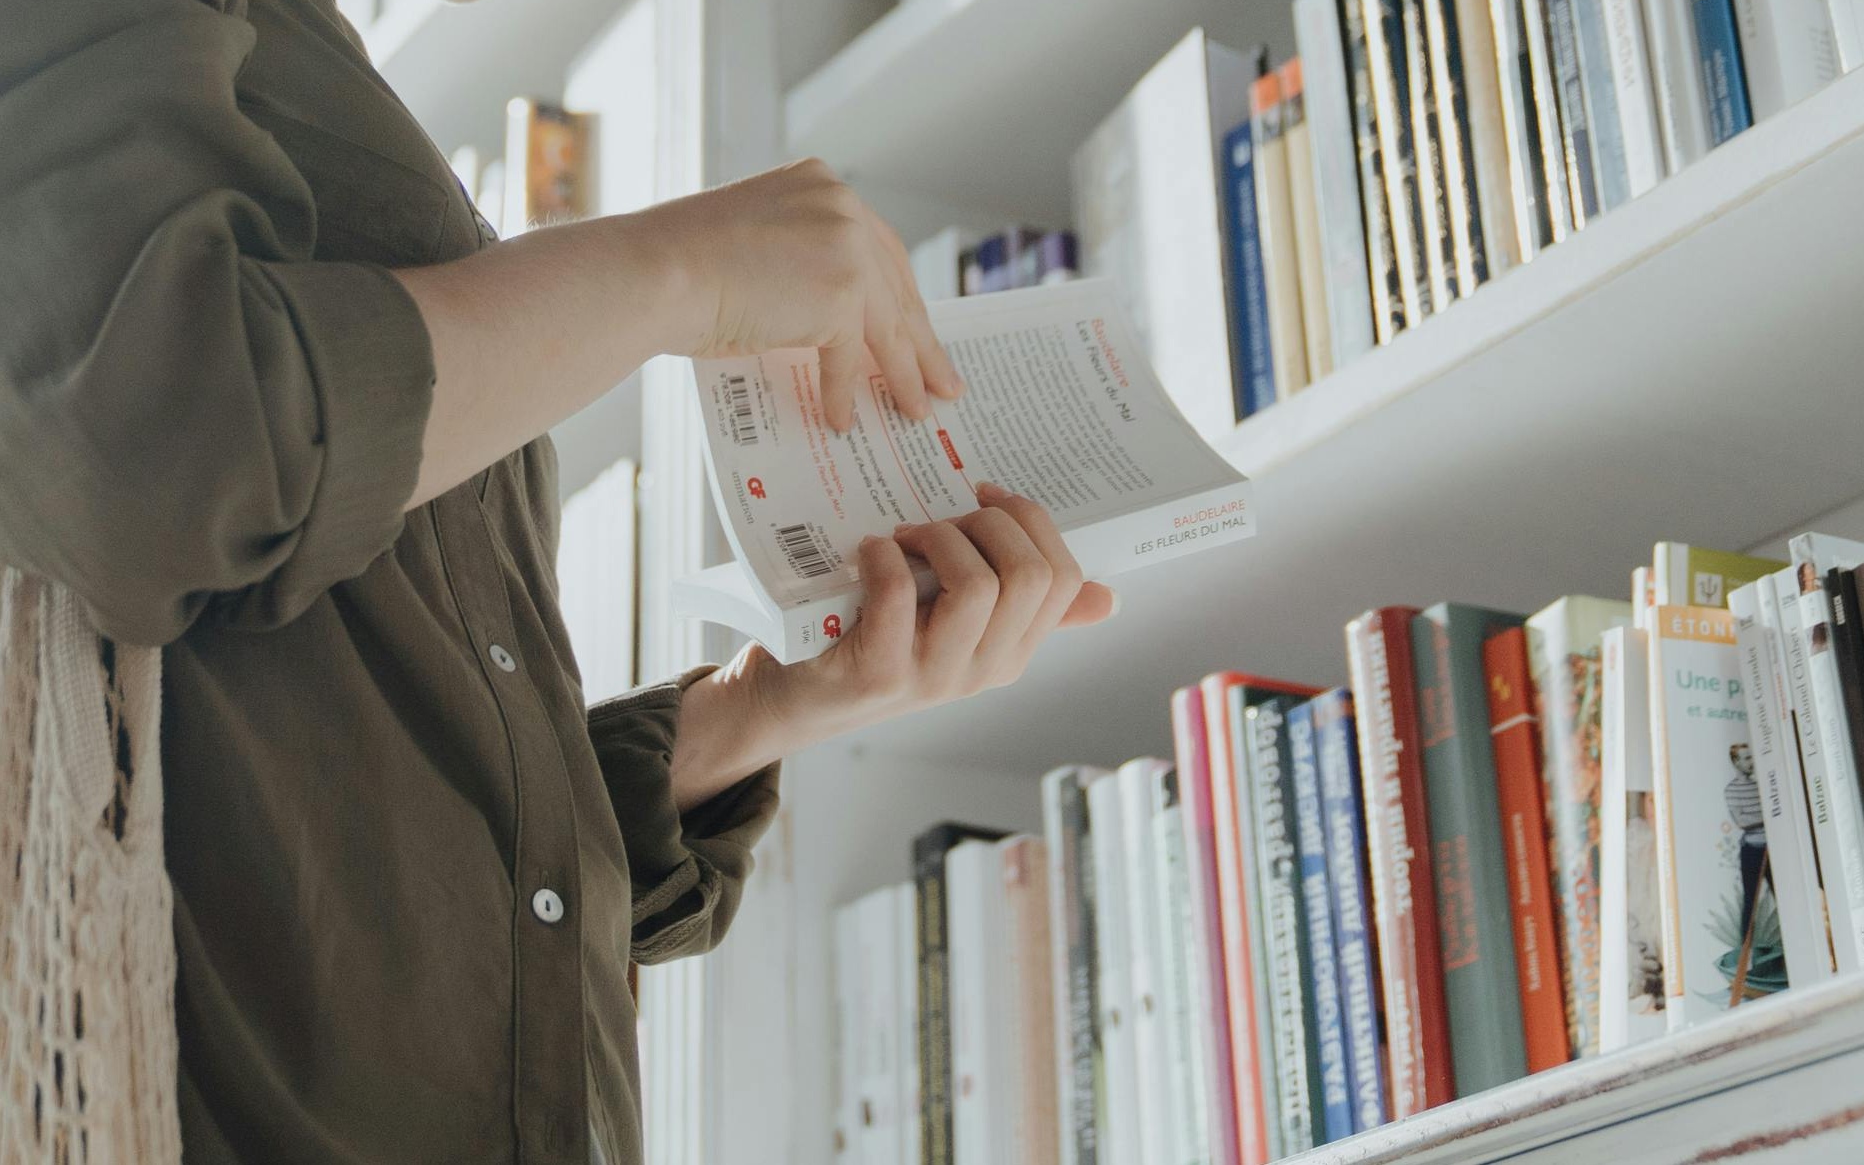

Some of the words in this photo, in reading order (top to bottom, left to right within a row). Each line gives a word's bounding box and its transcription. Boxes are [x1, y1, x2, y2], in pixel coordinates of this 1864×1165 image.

[1074, 319, 1092, 343] Les
[1084, 344, 1111, 384] Fleurs
[1105, 383, 1120, 401] du
[1115, 400, 1135, 424] Mal
[1088, 317, 1131, 389] Baudelaire
[1134, 540, 1154, 554] LES
[1155, 528, 1197, 548] FLEURS
[1199, 522, 1219, 536] DU
[1221, 515, 1246, 530] MAL
[1173, 499, 1246, 528] BAUDELAIRE
[1746, 644, 1766, 700] Grandet
[1786, 624, 1806, 680] Chabert
[1676, 669, 1721, 692] Une
[1793, 681, 1815, 740] Colonel
[1804, 740, 1817, 758] Le
[1764, 769, 1782, 818] Balzac
[1811, 774, 1828, 826] Balzac
